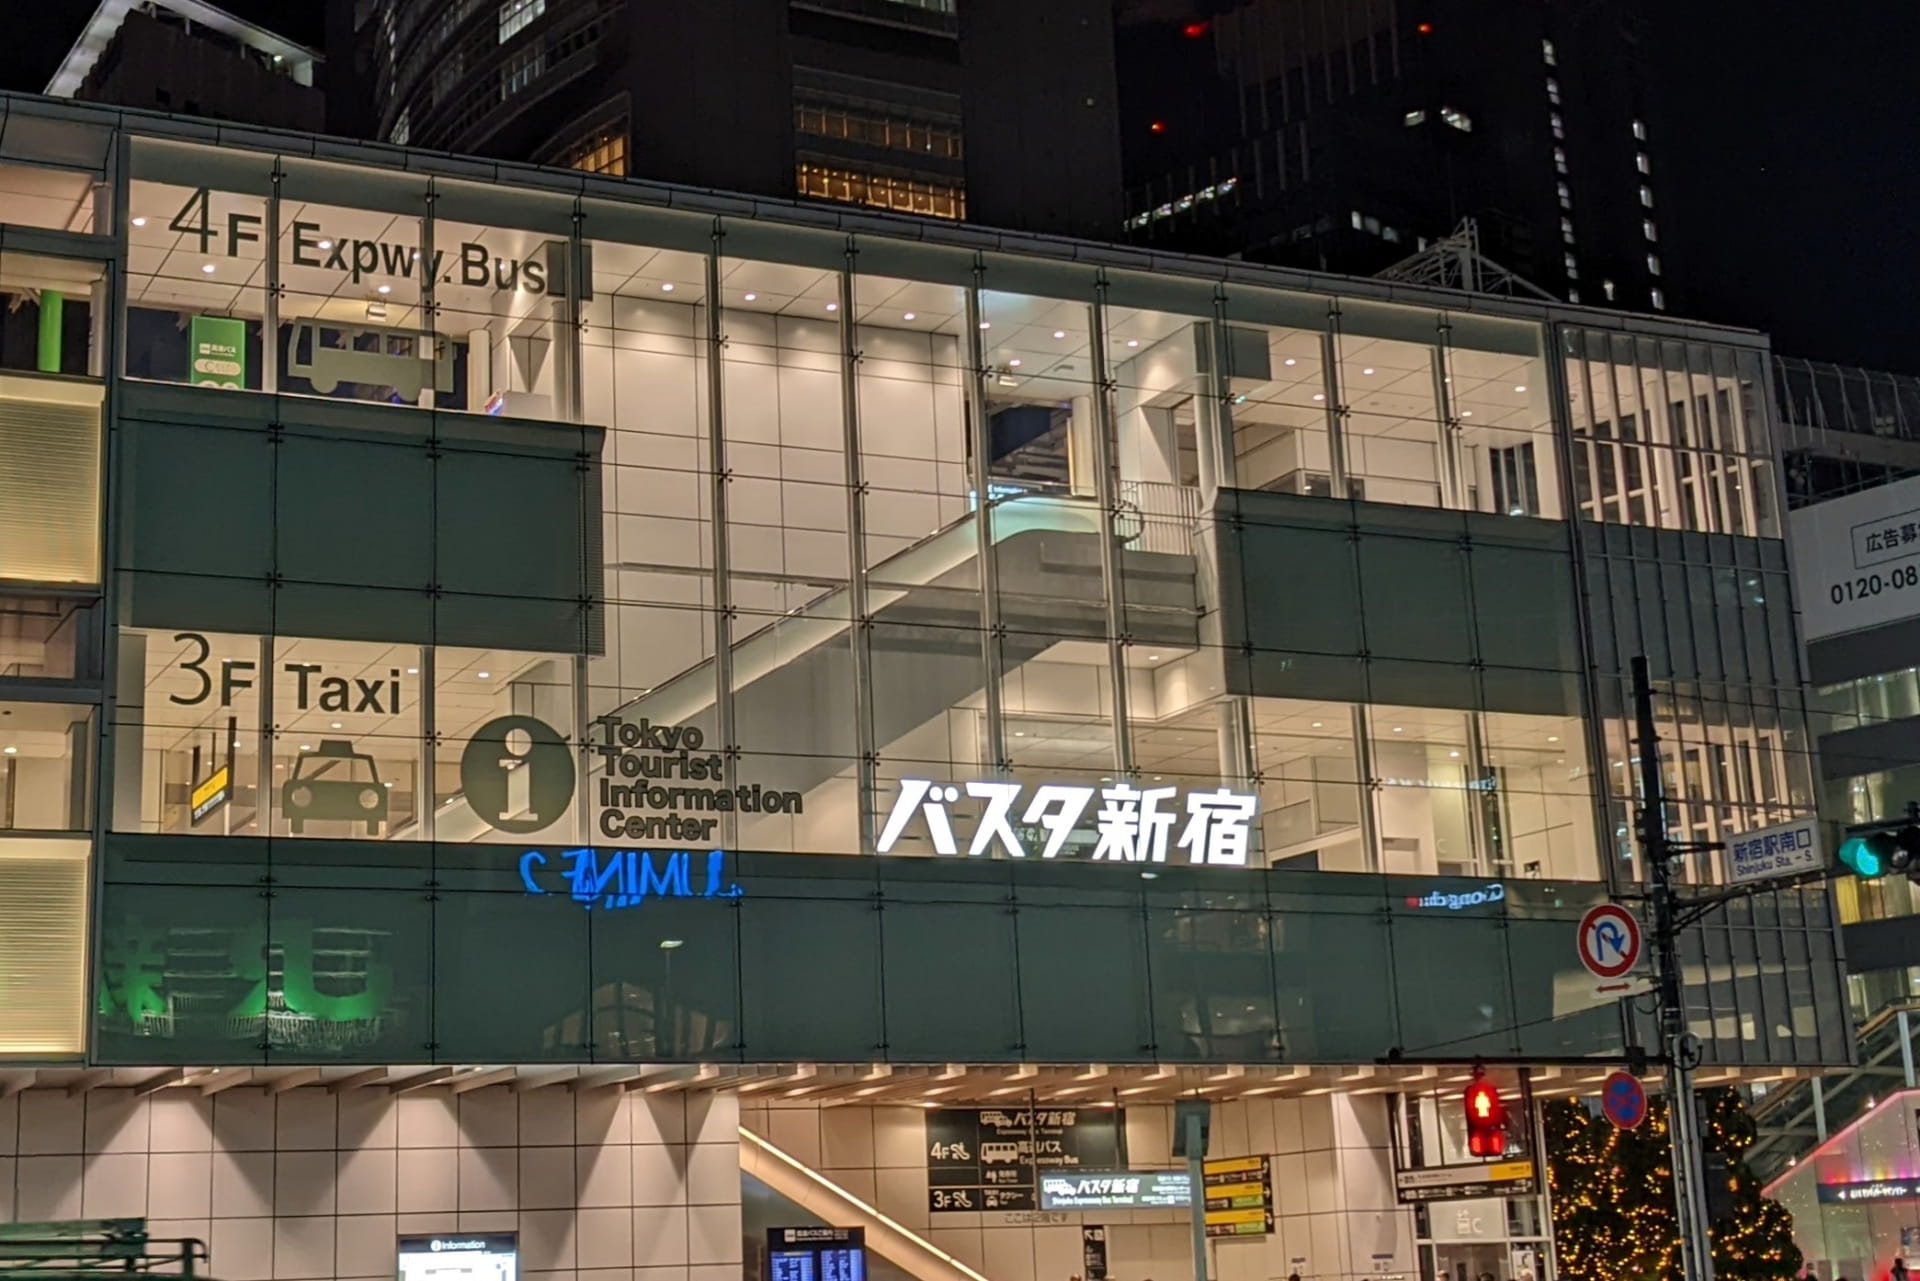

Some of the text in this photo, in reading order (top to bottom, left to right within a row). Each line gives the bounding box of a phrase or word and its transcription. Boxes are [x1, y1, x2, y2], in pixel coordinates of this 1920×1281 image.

[169, 187, 262, 257] 4F
[1866, 522, 1920, 553] 広告募
[1831, 563, 1920, 604] 0120-08
[169, 632, 400, 715] 3F Taxi
[598, 715, 704, 752] Tokyo
[598, 749, 723, 782] Tourist
[599, 779, 803, 815] Information
[599, 809, 718, 841] Center
[876, 777, 1258, 866] バスタ新宿
[1734, 828, 1812, 863] 新宿駅南口
[1736, 860, 1773, 877] Shinjuku
[1013, 1111, 1077, 1127] バスタ新宿
[931, 1142, 950, 1160] 4F
[933, 1190, 952, 1208] 3F
[1077, 1178, 1140, 1195] バスタ新宿
[442, 1240, 486, 1251] Information
